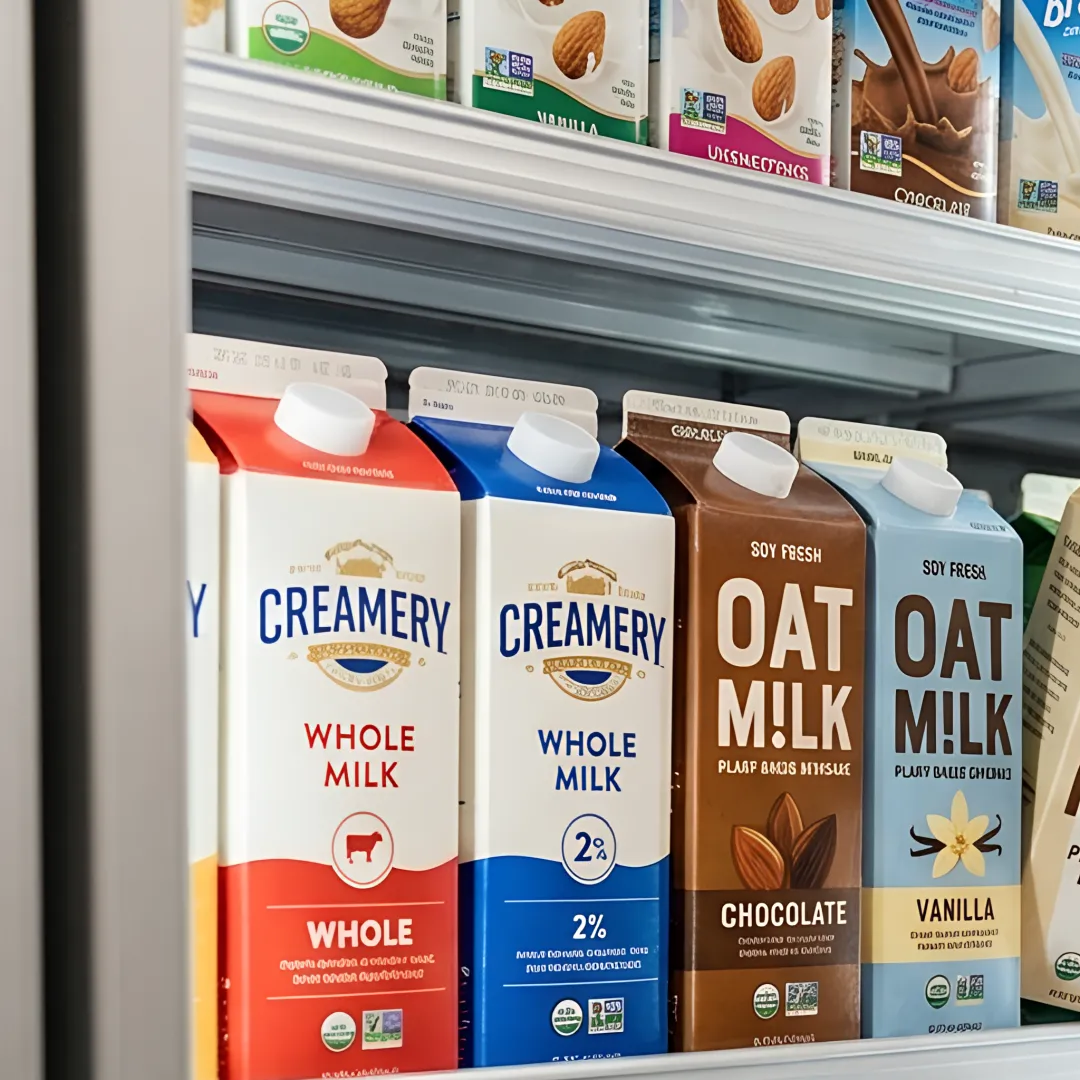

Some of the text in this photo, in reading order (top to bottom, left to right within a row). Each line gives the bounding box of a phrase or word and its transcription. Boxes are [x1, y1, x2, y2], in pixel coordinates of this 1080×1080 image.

[751, 541, 777, 559] SOY
[922, 560, 946, 576] SOY
[259, 585, 451, 655] CREAMERY
[499, 601, 667, 668] CREAMERY
[717, 577, 853, 672] OAT
[894, 594, 1013, 681] OAT
[304, 723, 415, 752] WHOLE
[537, 729, 637, 758] WHOLE
[324, 761, 399, 788] MILK
[555, 765, 622, 792] MILK
[721, 900, 847, 929] CHOCOLATE
[916, 897, 995, 922] VANILLA
[306, 918, 413, 949] WHOLE
[572, 913, 607, 940] 2%
